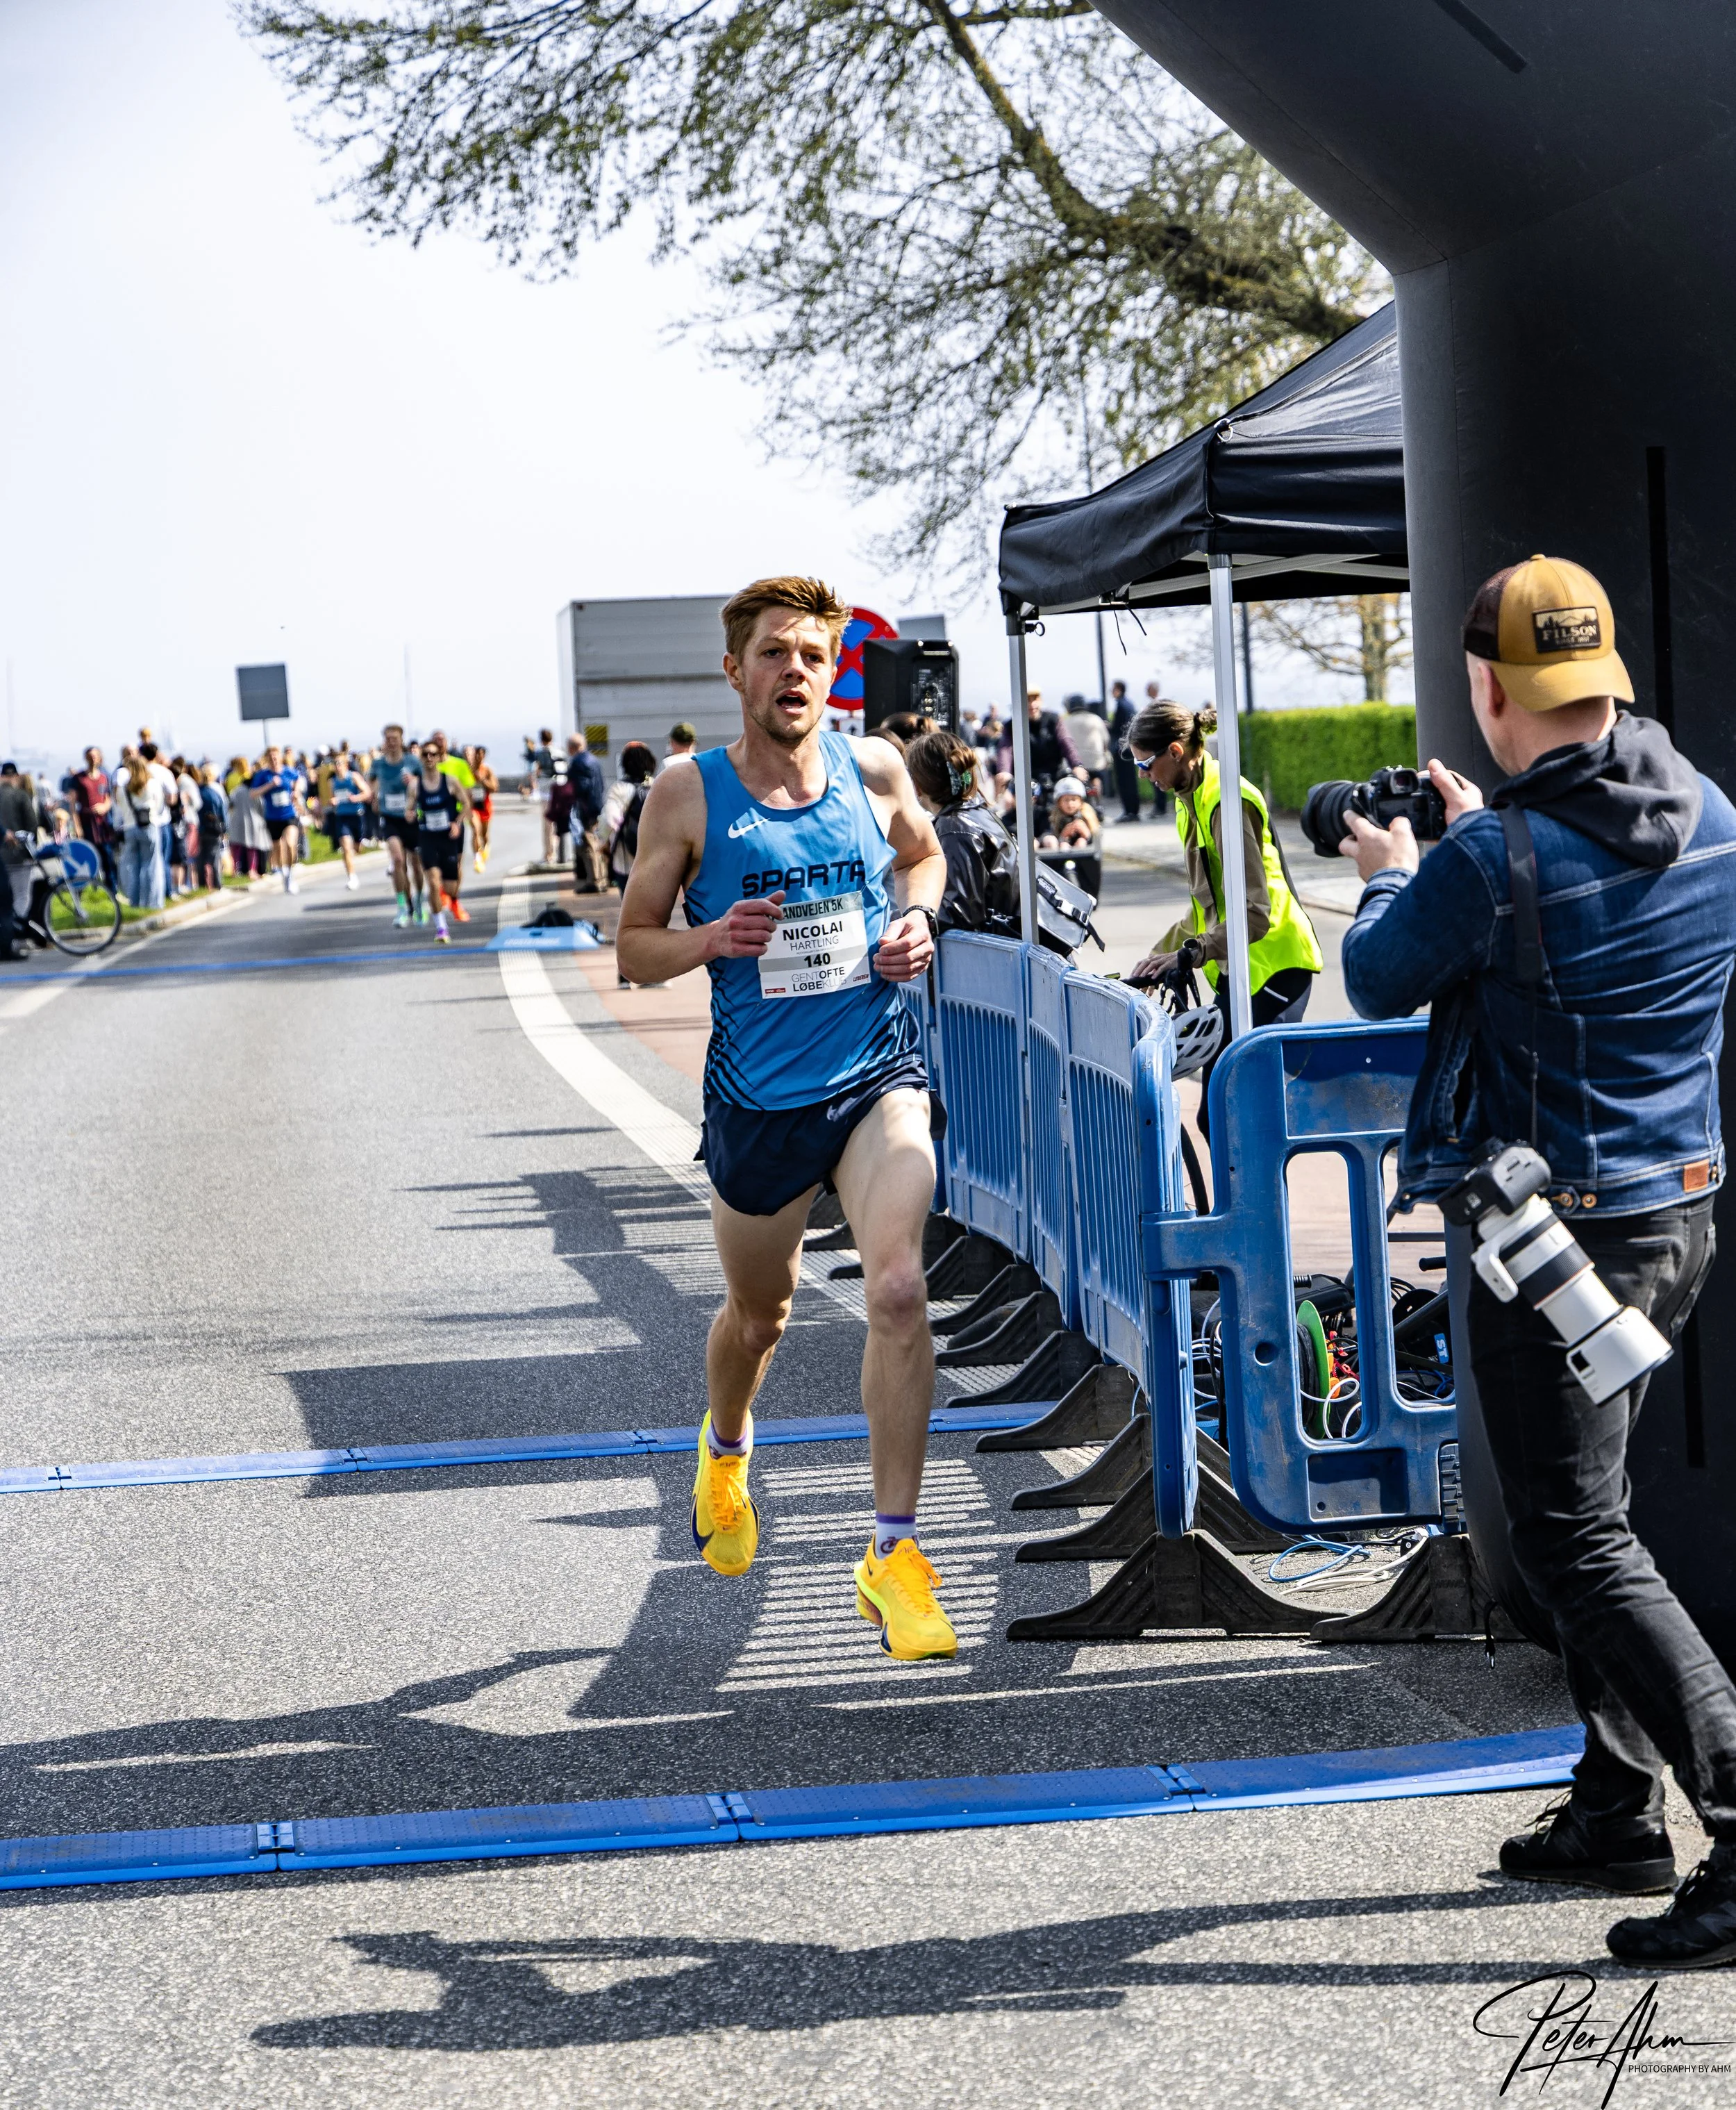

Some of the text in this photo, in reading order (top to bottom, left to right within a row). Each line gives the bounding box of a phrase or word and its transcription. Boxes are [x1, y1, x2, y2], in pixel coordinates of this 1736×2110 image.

[1543, 625, 1597, 640] FILSON
[742, 860, 866, 897] SPARTA
[783, 898, 844, 920] ANDVEJEN 5K
[783, 921, 843, 940] NICOLAI
[790, 936, 839, 951] HARTLING
[804, 952, 831, 967] 140
[792, 967, 845, 982] GENTOFTE
[793, 976, 847, 992] LØBEKLUB
[1437, 1339, 1448, 1357] ST
